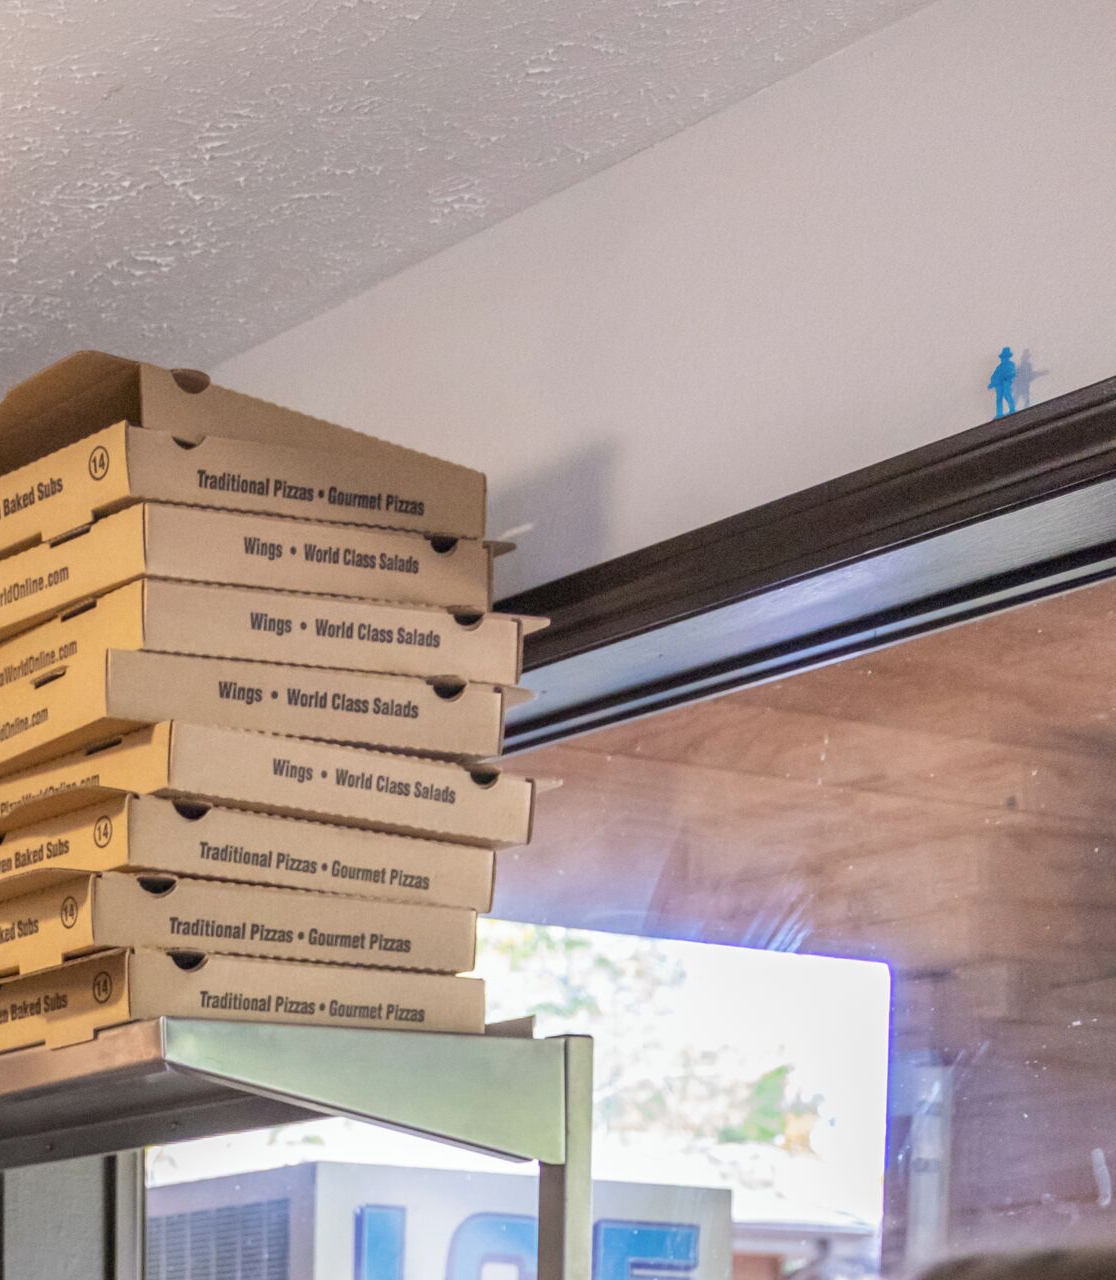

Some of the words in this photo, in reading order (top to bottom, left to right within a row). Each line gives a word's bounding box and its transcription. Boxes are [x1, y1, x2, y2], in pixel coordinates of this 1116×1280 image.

[3, 489, 35, 516] Baked
[36, 477, 64, 502] Subs
[197, 469, 270, 497] Traditional
[273, 481, 315, 502] Pizzas
[327, 486, 383, 511] Gourmet
[385, 493, 425, 516] Pizzas
[243, 536, 283, 561] Wings
[303, 543, 341, 565] World
[342, 548, 377, 569] Class
[379, 552, 420, 575] Salads
[250, 611, 292, 637] Wings
[315, 618, 354, 640] World
[357, 622, 394, 645] Class
[396, 627, 441, 649] Salads
[218, 680, 263, 705] Wings
[286, 687, 328, 709] World
[331, 693, 370, 714] Class
[372, 697, 420, 719] Salads
[272, 757, 314, 784] Wings
[335, 767, 373, 791] World
[375, 774, 411, 797] Class
[413, 780, 457, 805] Salads
[14, 845, 44, 869] Baked
[45, 838, 70, 860] Subs
[199, 841, 272, 868] Traditional
[275, 852, 318, 875] Pizzas
[331, 860, 387, 884] Gourmet
[389, 868, 430, 891] Pizzas
[17, 917, 39, 939] Subs
[168, 916, 246, 940] Traditional
[249, 923, 294, 944] Pizzas
[308, 928, 366, 950] Gourmet
[368, 933, 412, 953] Pizzas
[10, 997, 42, 1020] Baked
[43, 991, 69, 1013] Subs
[199, 990, 271, 1013] Traditional
[274, 995, 315, 1016] Pizzas
[328, 1000, 383, 1020] Gourmet
[385, 1004, 426, 1023] Pizzas
